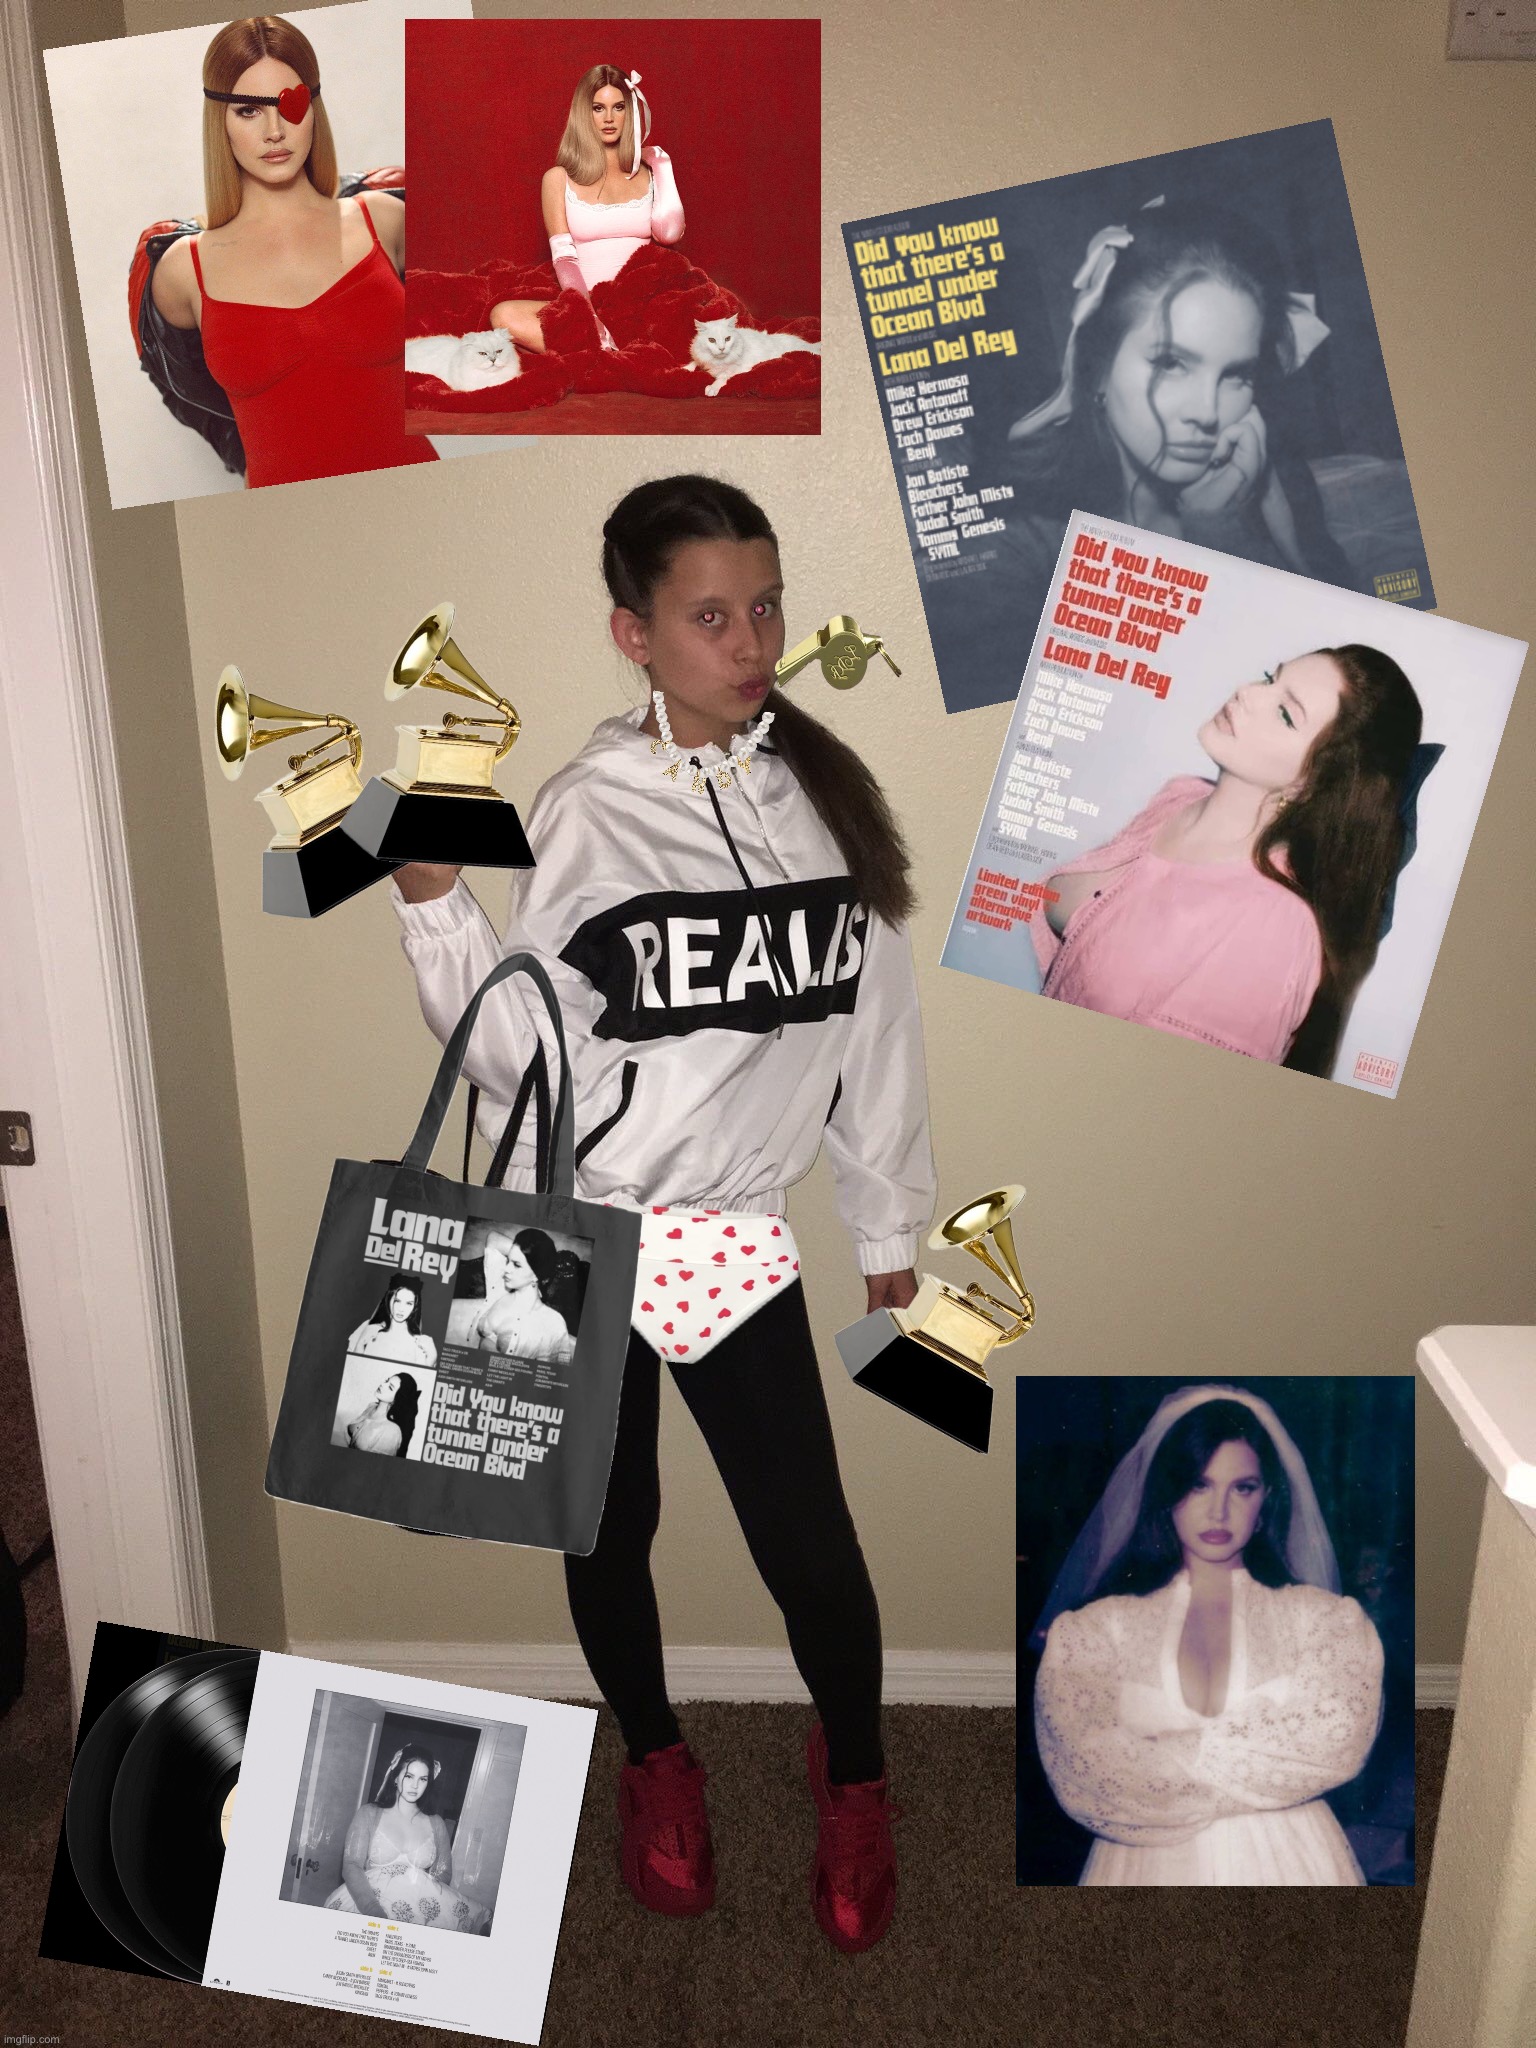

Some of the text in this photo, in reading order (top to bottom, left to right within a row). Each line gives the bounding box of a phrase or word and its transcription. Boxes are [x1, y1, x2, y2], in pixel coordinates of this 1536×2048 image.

[853, 236, 890, 266] Did
[938, 216, 1000, 247] know
[860, 242, 1005, 289] that there's a
[866, 269, 998, 314] tunnel under
[870, 293, 986, 339] Ocean Blvd
[878, 347, 931, 376] Lana
[933, 335, 969, 364] Del
[972, 329, 1018, 356] Rey
[885, 385, 916, 402] Mike
[917, 374, 969, 395] Hermosa
[890, 388, 969, 417] Jack Antonoff
[891, 405, 974, 433] Drew Erickson
[895, 423, 964, 448] Zach Dawes
[906, 442, 936, 461] Benji
[906, 473, 926, 489] Jon
[927, 464, 969, 484] Batiste
[907, 481, 964, 504] Bleachers
[911, 485, 1015, 519] Father John Misty
[915, 506, 985, 533] Judah Smith
[917, 517, 1006, 548] Tommy Genesis
[1072, 533, 1108, 563] Did
[1151, 556, 1209, 593] know
[1067, 558, 1202, 615] that there's a
[1061, 581, 1186, 635] tunnel under
[1053, 603, 1113, 639] Ocean
[1115, 620, 1162, 653] Blvd
[1043, 636, 1092, 670] Lana
[1094, 651, 1129, 680] Del
[1130, 661, 1172, 700] Rey
[1031, 684, 1056, 702] Jack
[1023, 712, 1087, 742] Zach Dawes
[1027, 699, 1104, 732] Drew Erickson
[1008, 764, 1061, 791] Bleachers
[1012, 750, 1073, 780] Jon Batiste
[1004, 777, 1040, 799] Father
[1041, 787, 1067, 807] John
[1000, 793, 1065, 822] Judah Smith
[1037, 817, 1079, 840] Genesis
[977, 867, 1020, 891] Limited
[969, 895, 1032, 923] alternative
[974, 883, 1040, 912] green vinyl
[965, 909, 1013, 931] artwork
[369, 1197, 465, 1250] Lana
[365, 1234, 458, 1284] Del Rey
[433, 1381, 564, 1425] Did You know
[430, 1402, 561, 1446] that there's a
[427, 1422, 549, 1463] tunnel under
[422, 1442, 527, 1481] Ocean Blvd
